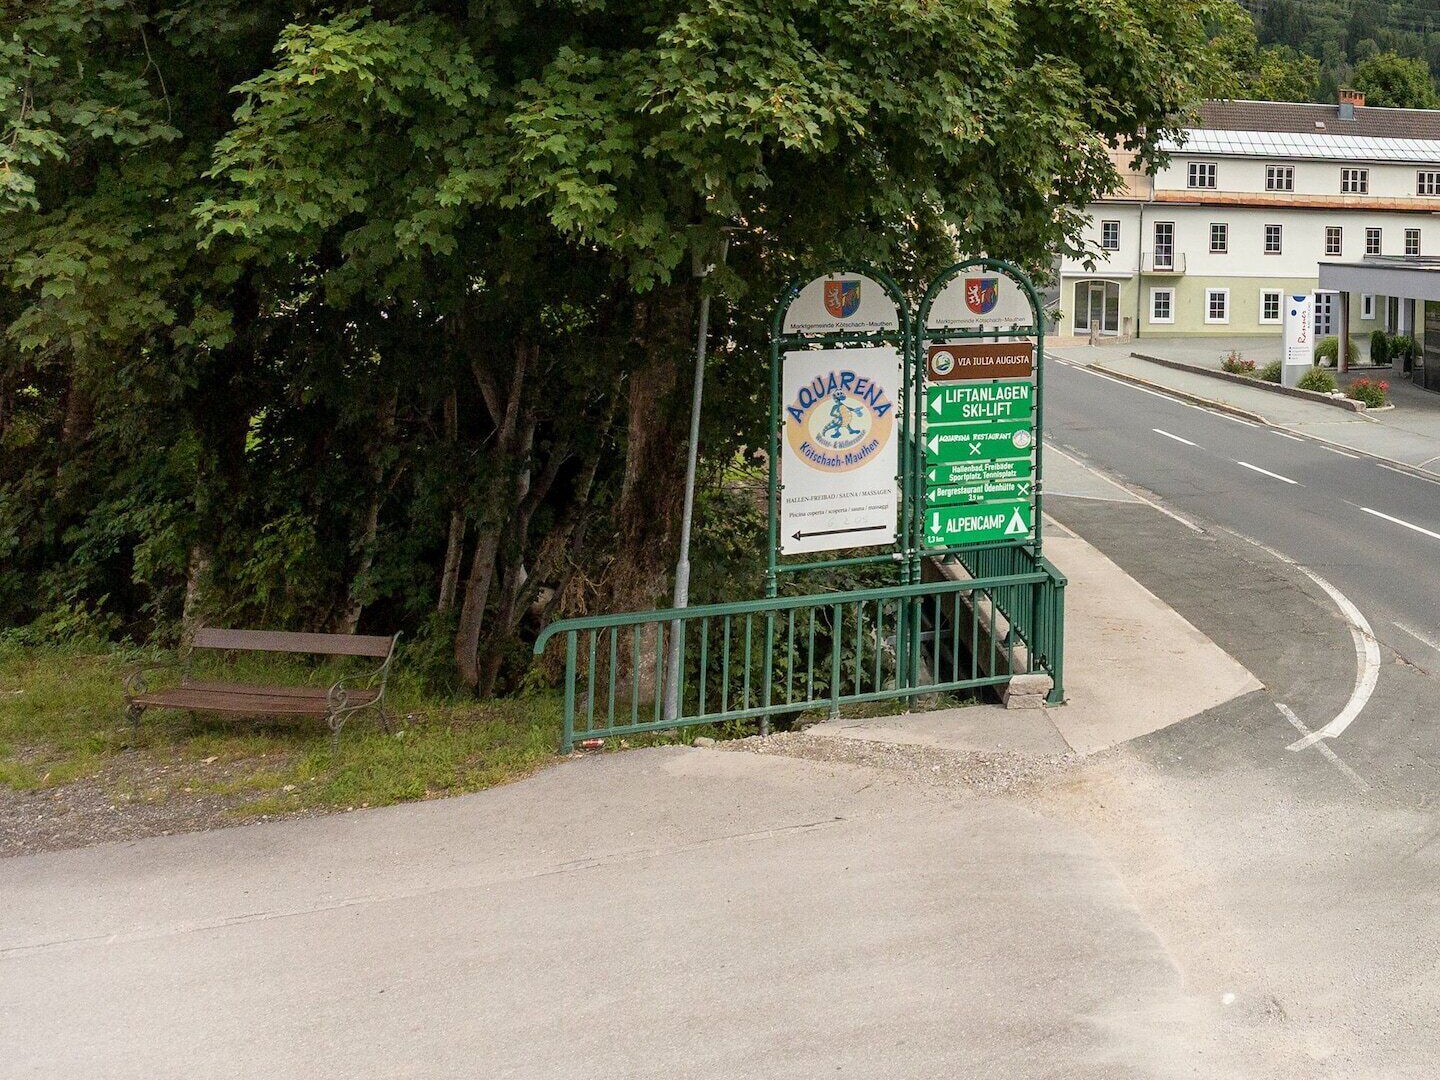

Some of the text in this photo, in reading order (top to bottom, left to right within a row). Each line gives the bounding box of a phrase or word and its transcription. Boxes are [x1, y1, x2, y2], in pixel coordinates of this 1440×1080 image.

[790, 322, 834, 330] Marktgemeinde
[958, 355, 1030, 366] VIA IULIA AUGUSTA
[787, 371, 892, 424] AQUARENA
[945, 385, 1029, 403] LIFTANLAGEN
[962, 401, 1012, 418] SKI-LIFT
[972, 432, 1012, 441] RESTAURANT
[983, 470, 1017, 479] Tennisplatz
[786, 493, 836, 504] HALLEN-FREIBAD
[862, 489, 892, 497] MASSAGEN
[937, 484, 983, 497] Bergrestaurant
[946, 514, 1006, 534] ALPENCAMP
